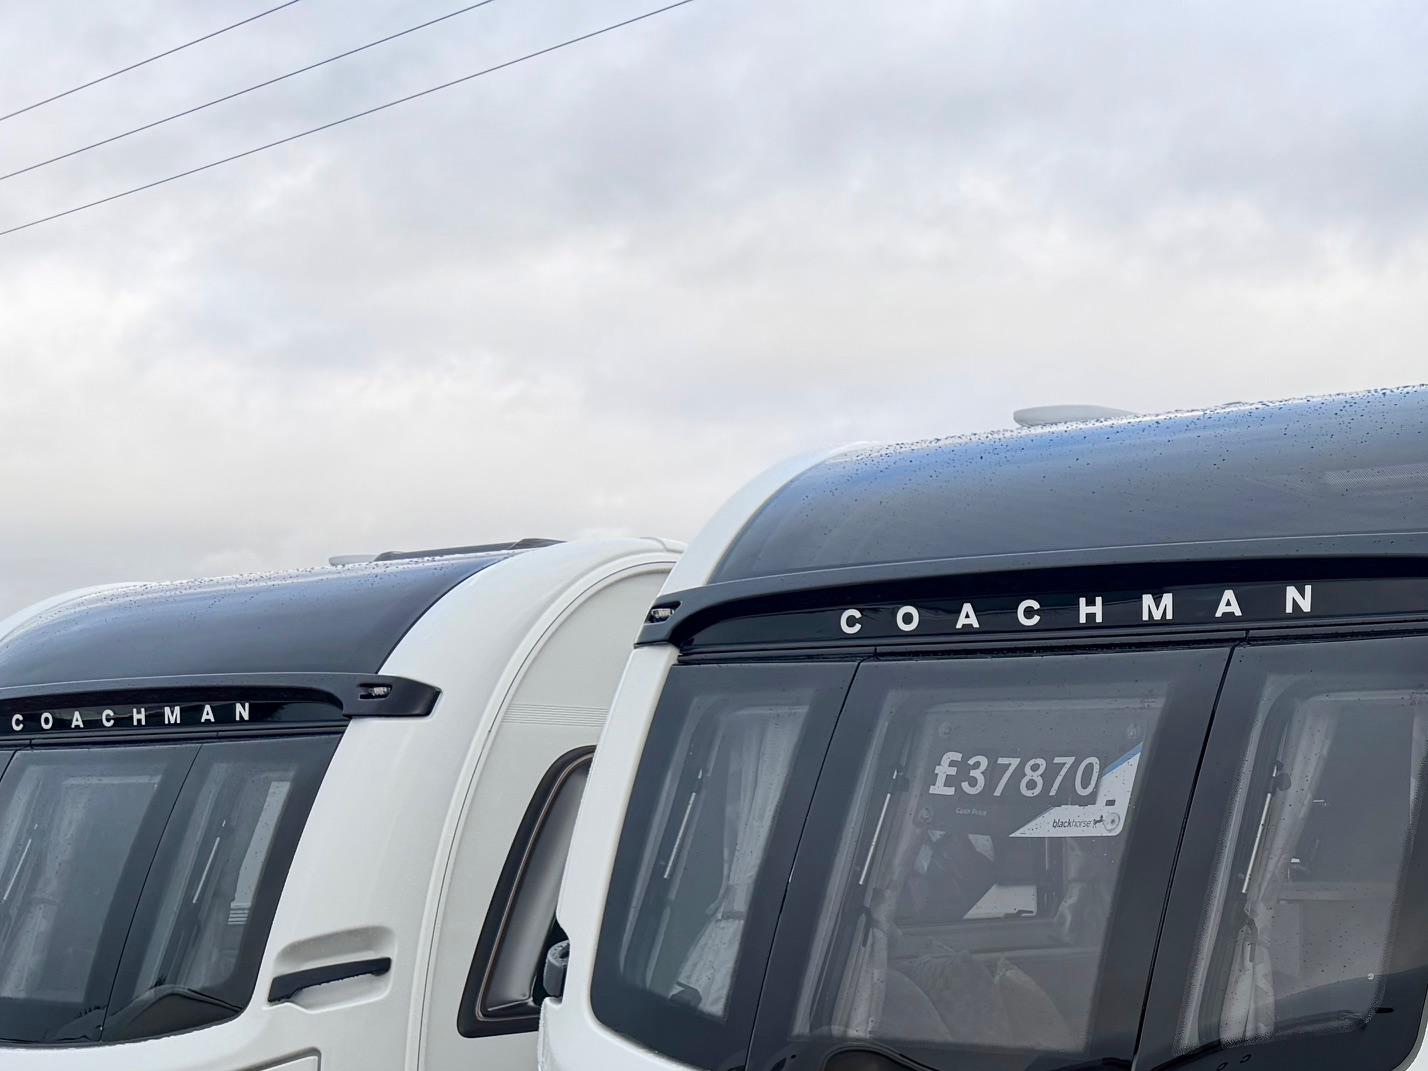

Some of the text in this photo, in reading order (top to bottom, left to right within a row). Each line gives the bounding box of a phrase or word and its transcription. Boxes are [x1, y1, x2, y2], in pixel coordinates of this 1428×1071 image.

[840, 585, 1312, 634] COACHMAN
[11, 703, 249, 731] COACHMAN
[928, 751, 1100, 797] £37870
[1052, 817, 1092, 828] blackhorse
